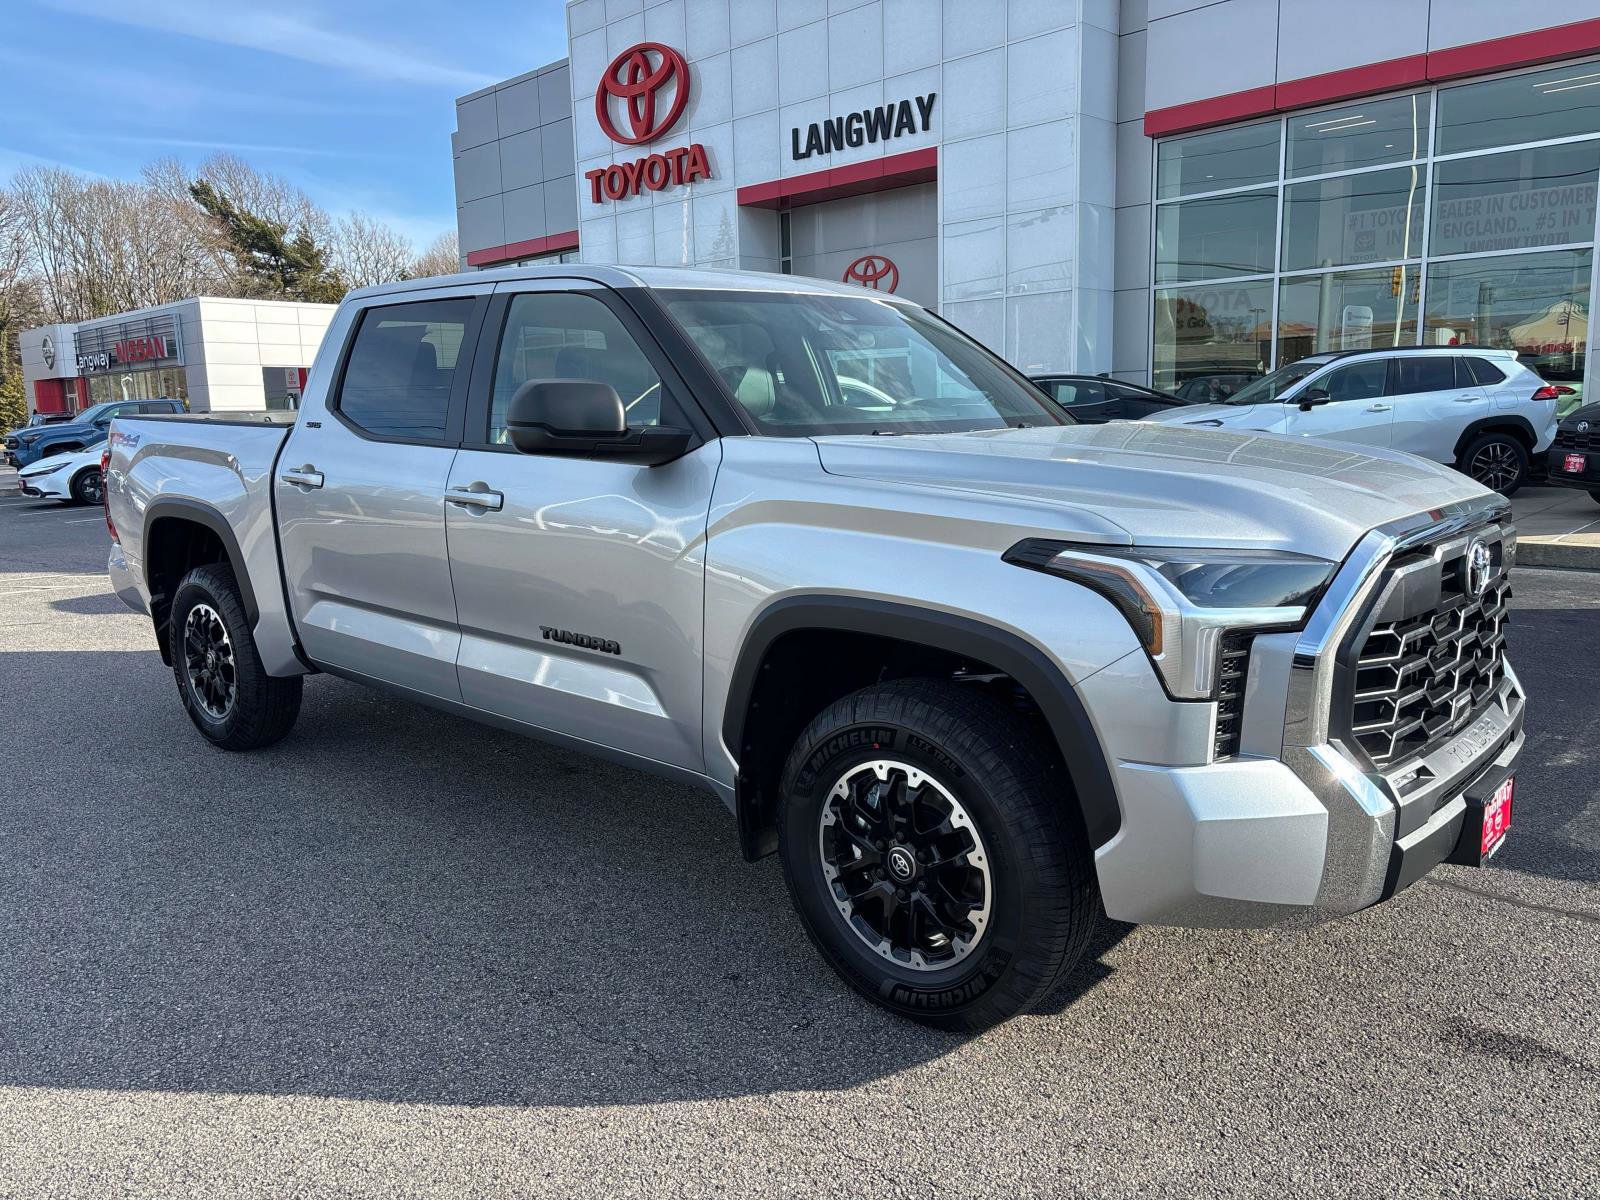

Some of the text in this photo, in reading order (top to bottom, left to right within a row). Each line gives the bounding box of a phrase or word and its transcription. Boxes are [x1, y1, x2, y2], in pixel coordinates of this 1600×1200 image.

[791, 92, 936, 161] LANGWAY
[585, 143, 711, 204] TOYOTA
[1436, 201, 1481, 220] EALER
[1486, 196, 1504, 214] IN
[1510, 187, 1594, 211] CUSTOMER
[1385, 228, 1402, 245] IN
[1536, 212, 1555, 231] #5
[1562, 209, 1580, 226] IN
[76, 335, 168, 371] Langway NISSAN
[539, 625, 621, 655] TUNDRA
[810, 729, 892, 771] MICHELIN
[934, 749, 959, 773] TRAIL
[1447, 718, 1500, 764] TUNDRA
[895, 972, 987, 1008] MICHELIN
